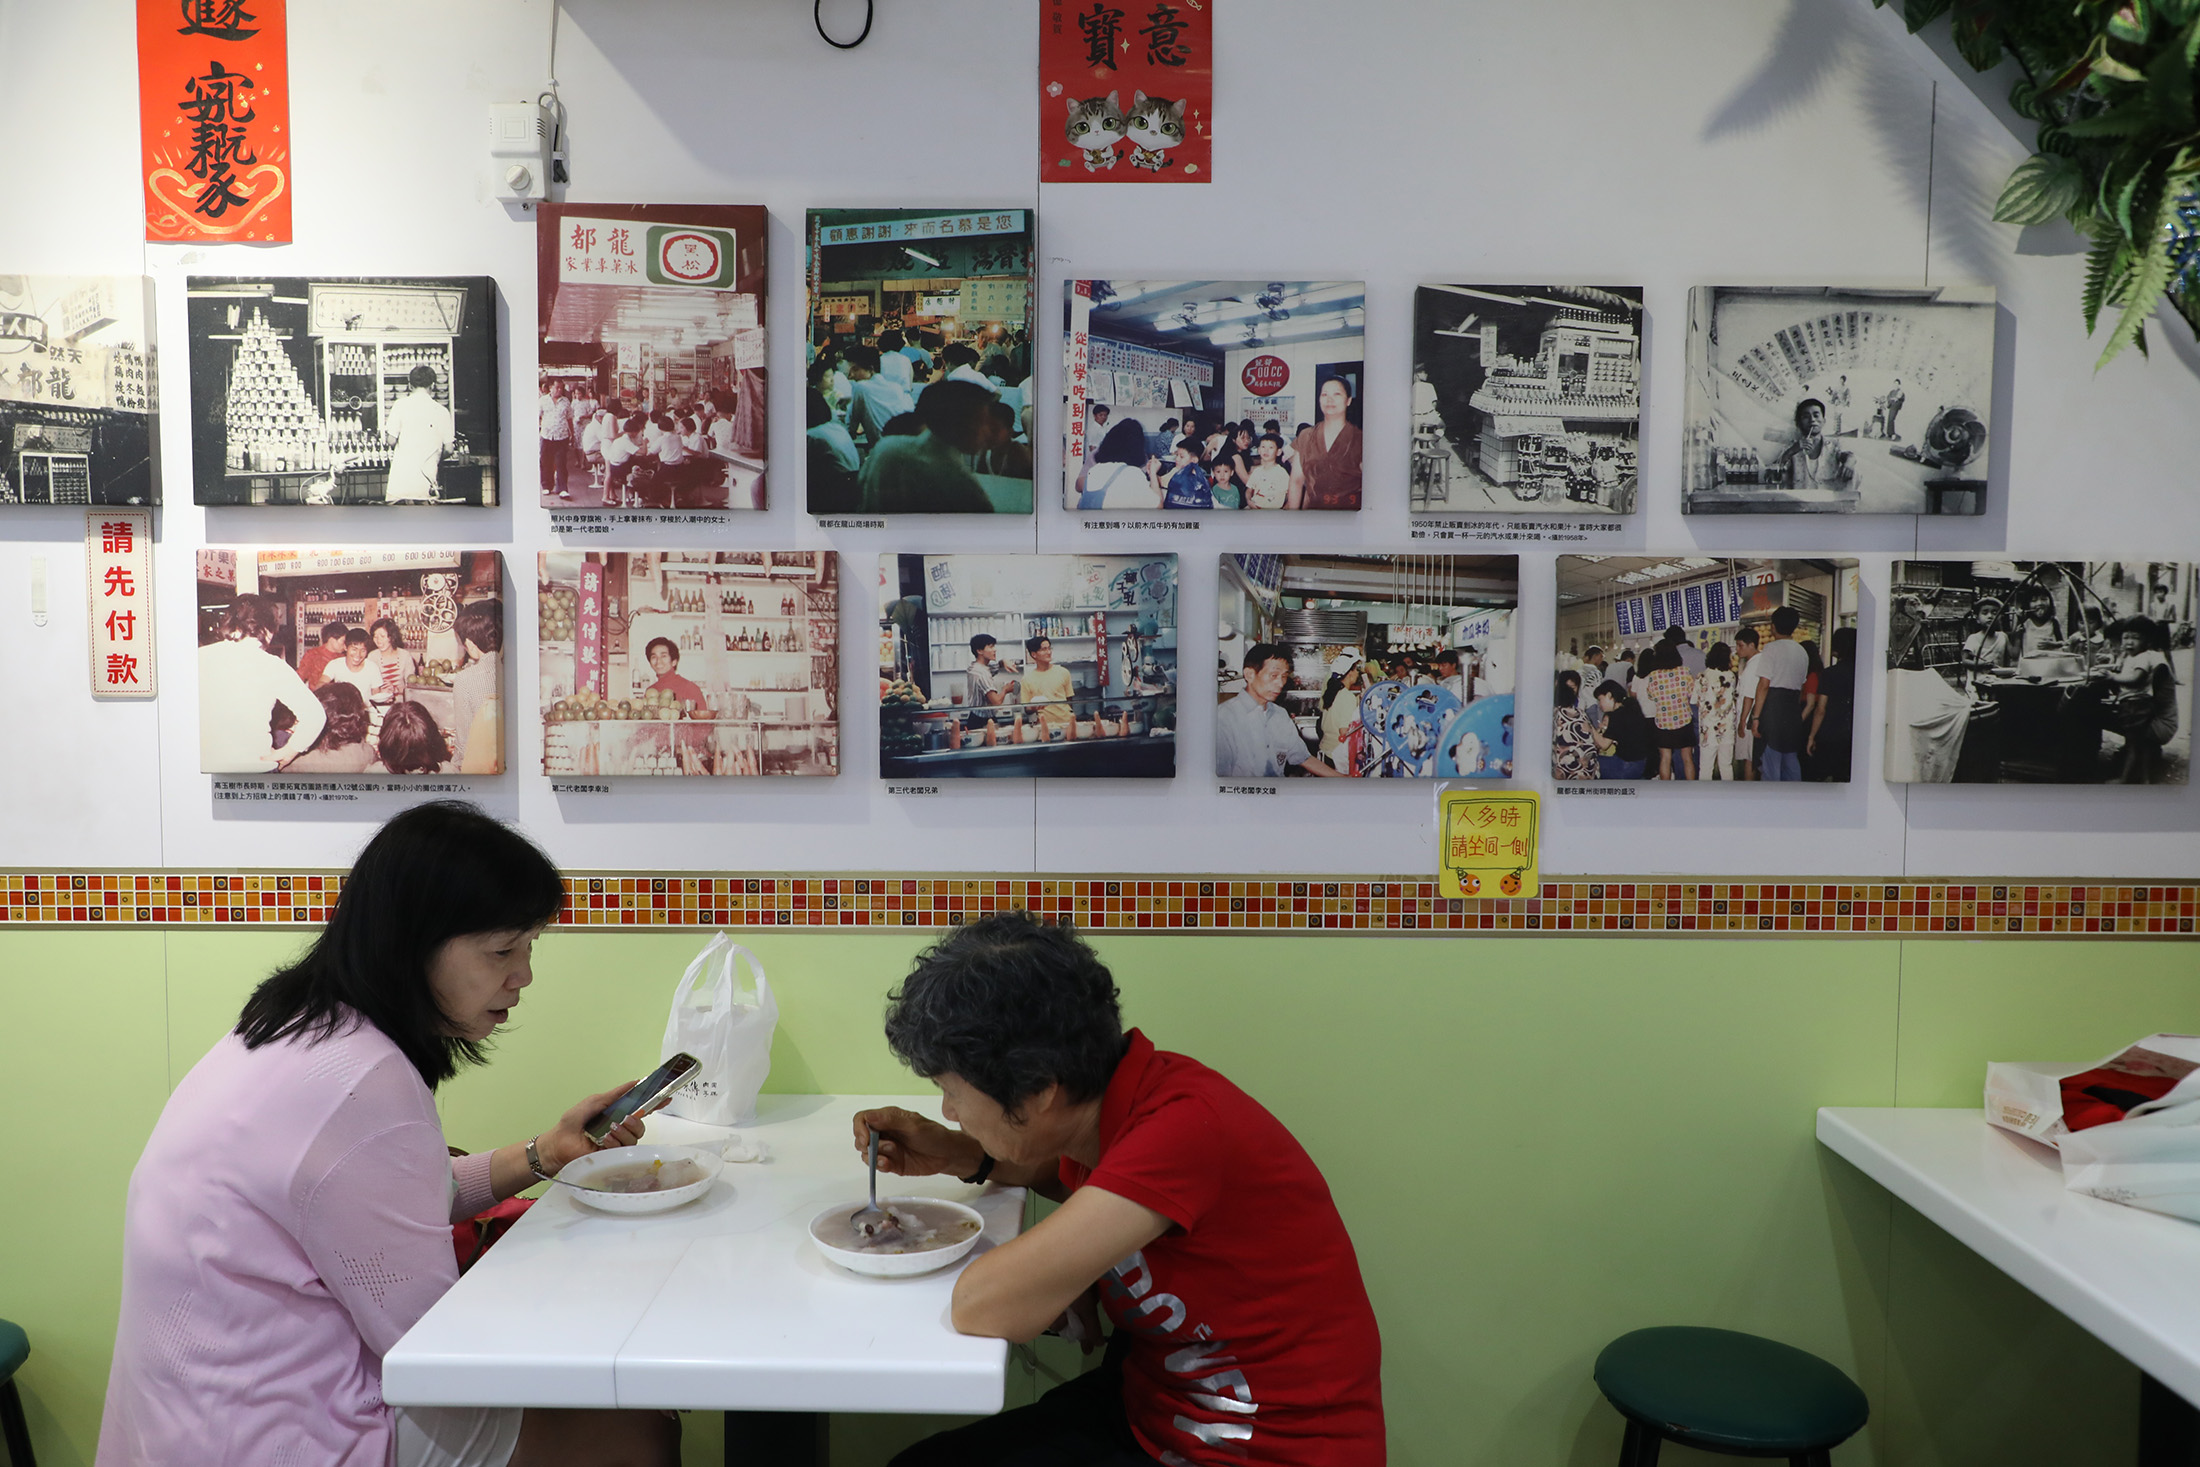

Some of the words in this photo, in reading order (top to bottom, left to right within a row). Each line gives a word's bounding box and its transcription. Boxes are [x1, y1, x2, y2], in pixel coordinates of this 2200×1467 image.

[1071, 331, 1088, 457] 從小學吃到現在
[101, 522, 139, 684] 請先付款
[581, 572, 600, 665] 請先付款
[888, 786, 939, 795] 第三代老闆兄弟
[1457, 805, 1521, 828] 人多時
[1451, 835, 1529, 858] 請坐同一側
